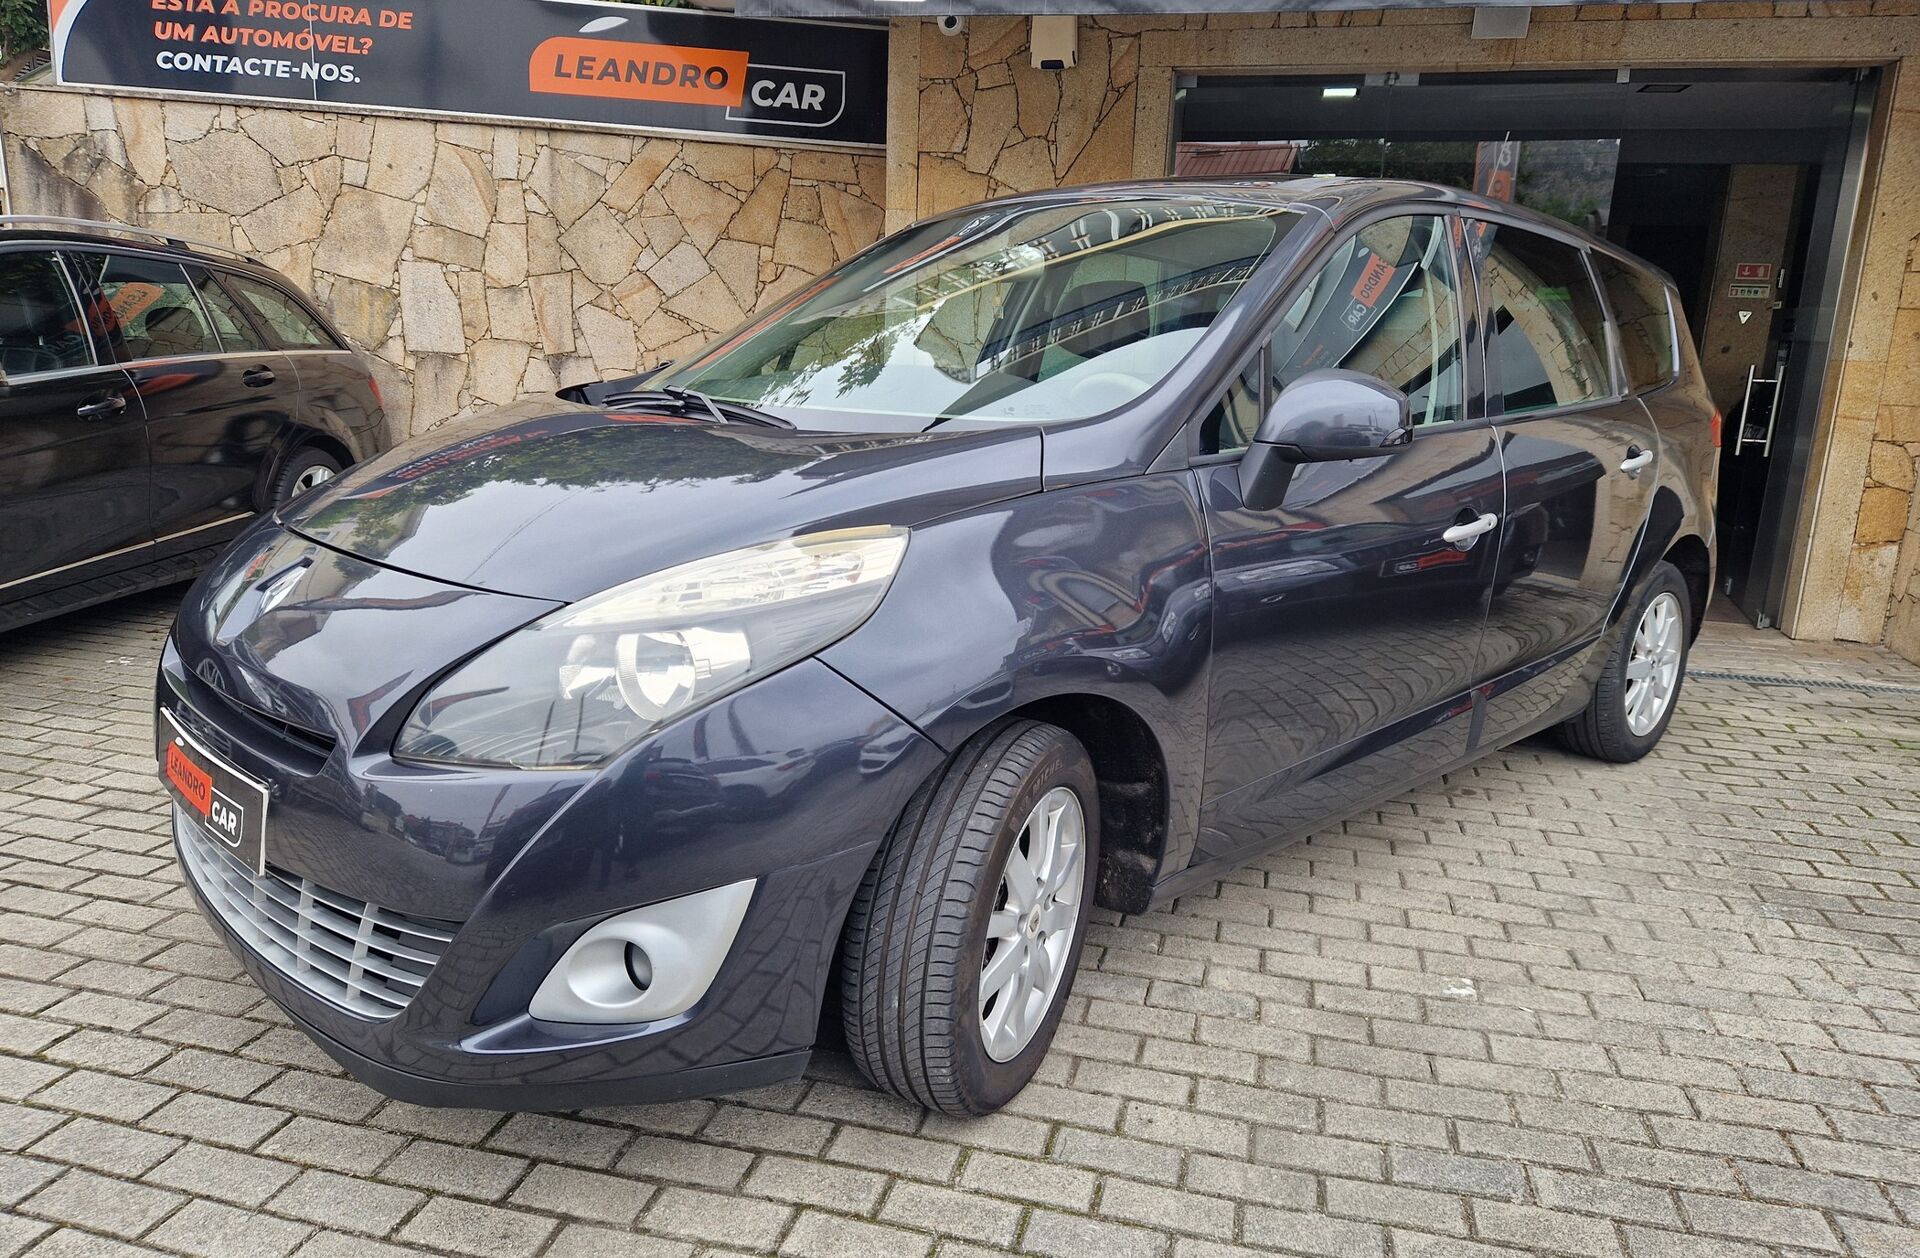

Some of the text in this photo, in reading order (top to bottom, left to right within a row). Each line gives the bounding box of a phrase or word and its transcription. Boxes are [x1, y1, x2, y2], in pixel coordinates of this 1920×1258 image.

[247, 1, 372, 26] PROCURA
[378, 10, 414, 30] DE
[154, 20, 373, 55] UM AUTOMÓVEL?
[156, 51, 361, 84] CONTACTE-NOS.
[553, 53, 827, 112] LEANDRO CAR
[170, 750, 237, 836] LEANDRO CAR
